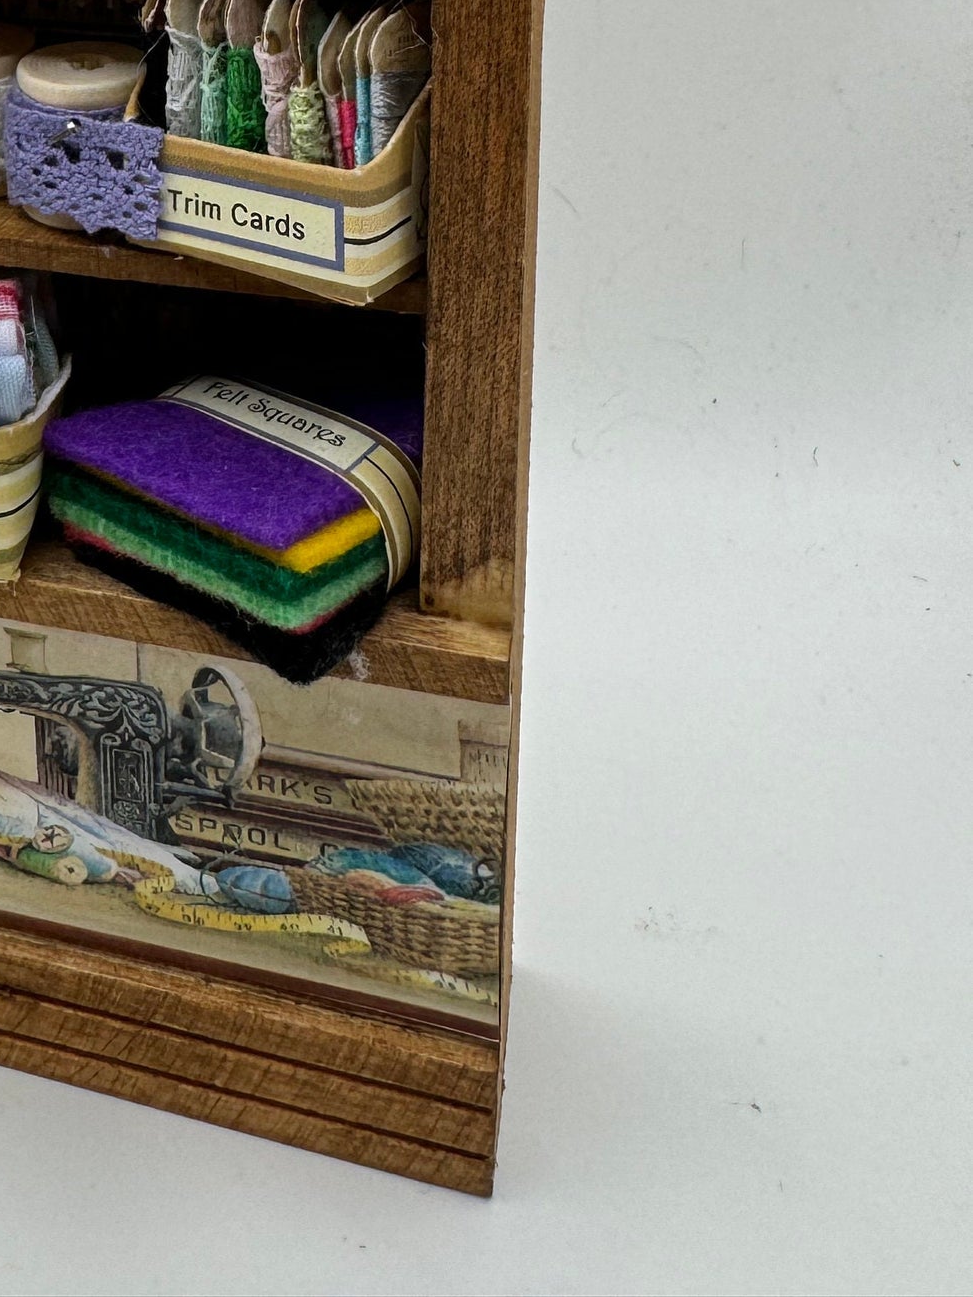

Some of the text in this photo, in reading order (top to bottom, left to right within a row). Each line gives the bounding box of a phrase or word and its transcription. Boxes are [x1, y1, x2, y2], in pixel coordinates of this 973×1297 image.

[167, 188, 306, 241] Trim Cards
[203, 381, 347, 447] Felt Squares
